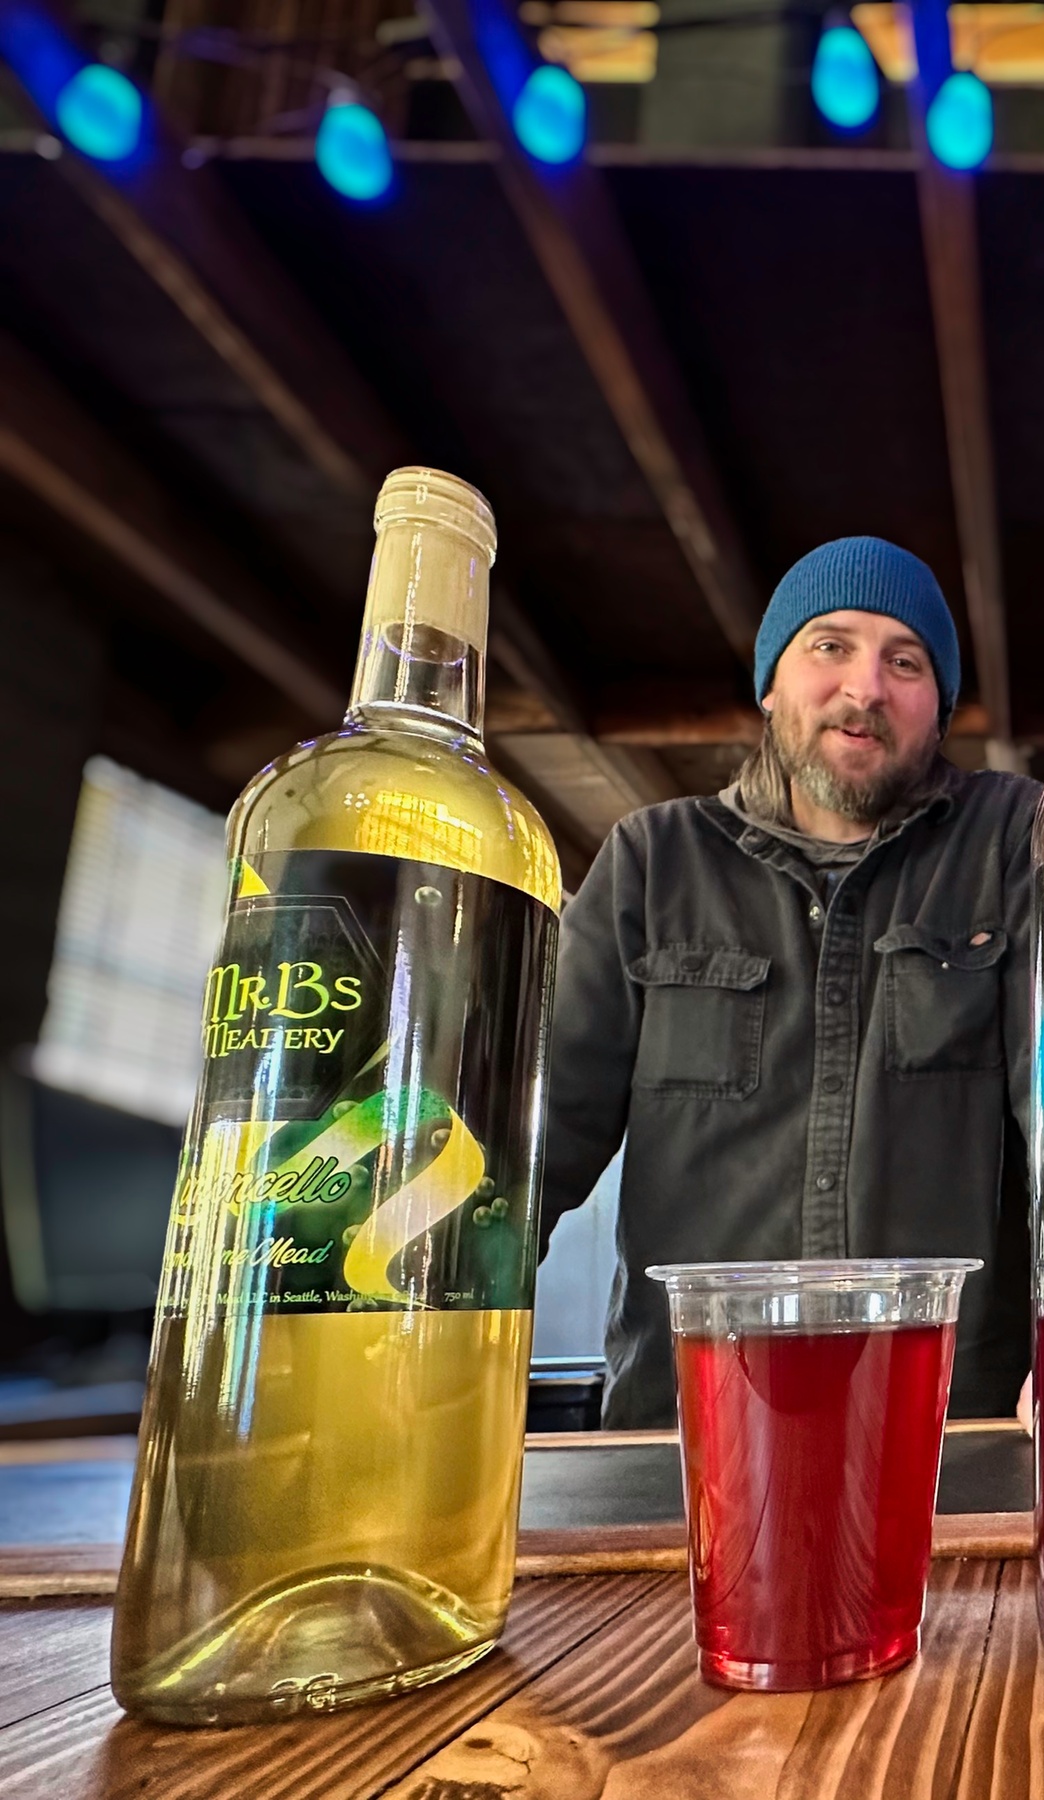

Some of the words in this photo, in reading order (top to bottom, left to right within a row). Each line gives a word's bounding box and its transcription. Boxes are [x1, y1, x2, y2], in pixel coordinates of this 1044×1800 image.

[269, 1291, 282, 1305] in
[283, 1288, 324, 1305] Seattle,
[444, 1291, 462, 1302] 750
